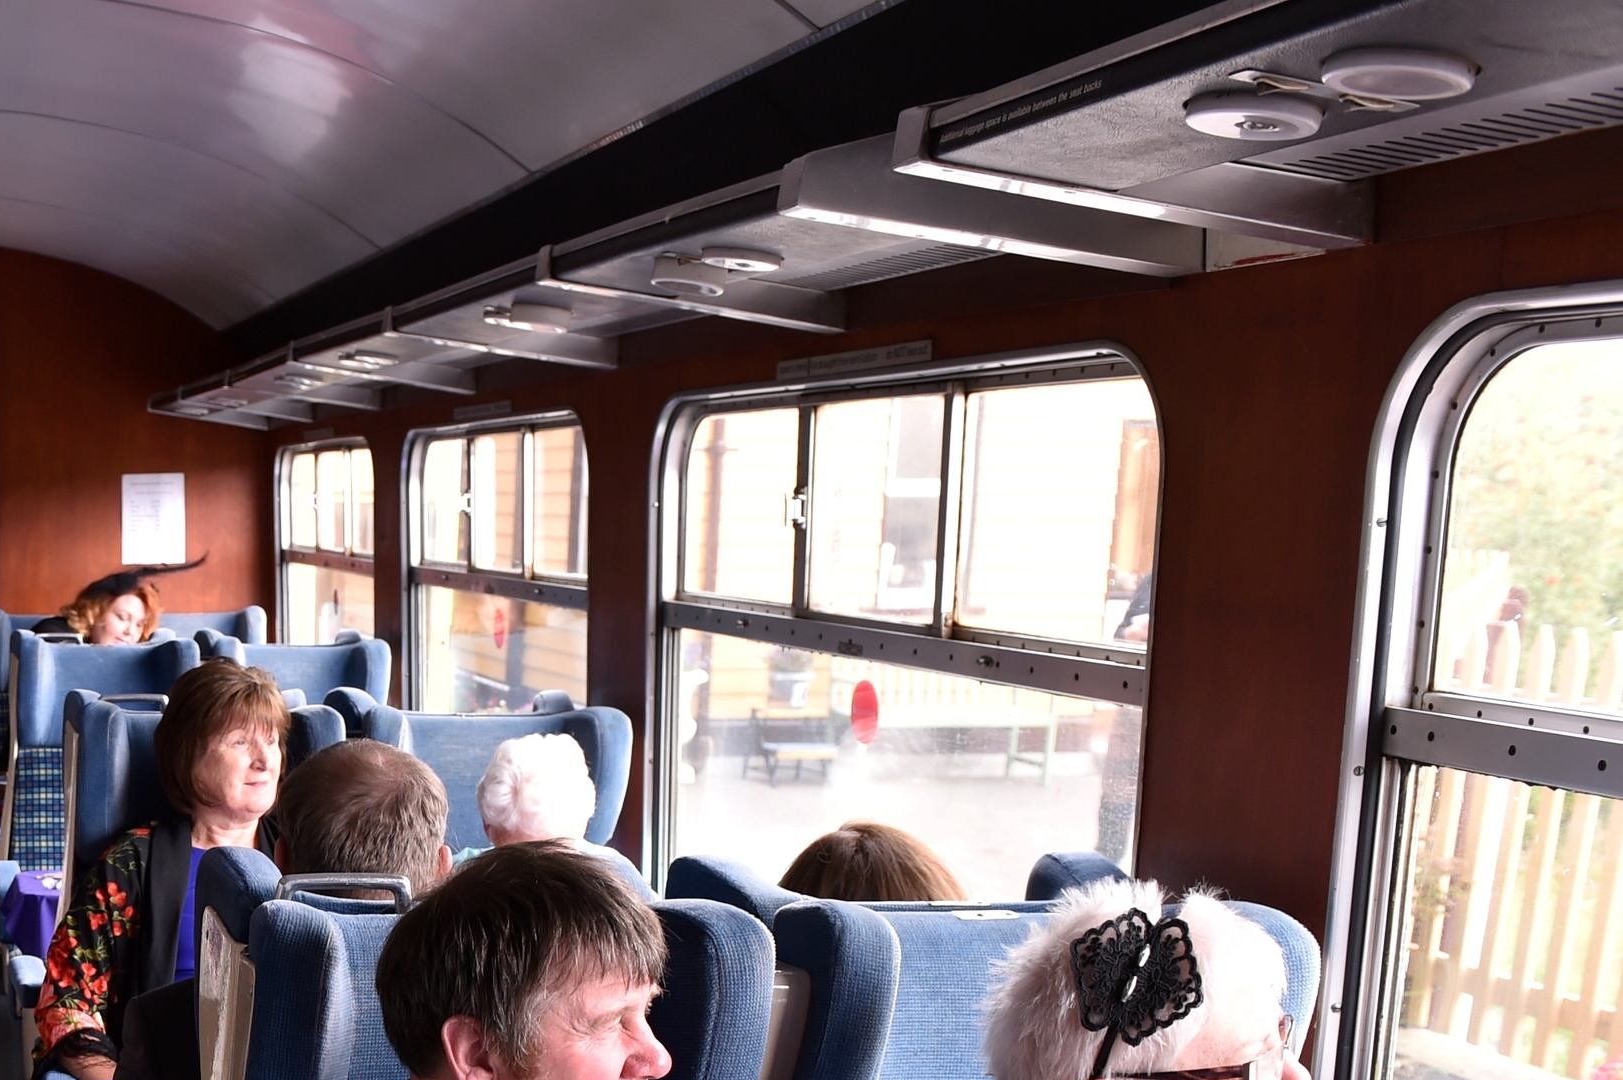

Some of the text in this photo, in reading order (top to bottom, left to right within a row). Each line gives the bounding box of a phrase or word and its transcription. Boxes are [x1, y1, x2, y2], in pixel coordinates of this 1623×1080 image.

[938, 129, 964, 143] Additional
[963, 122, 986, 137] luggage
[984, 117, 1002, 129] space
[1006, 105, 1031, 120] available
[1031, 96, 1057, 111] between
[1056, 92, 1069, 102] the
[1068, 87, 1083, 98] seat
[1082, 80, 1103, 93] backs
